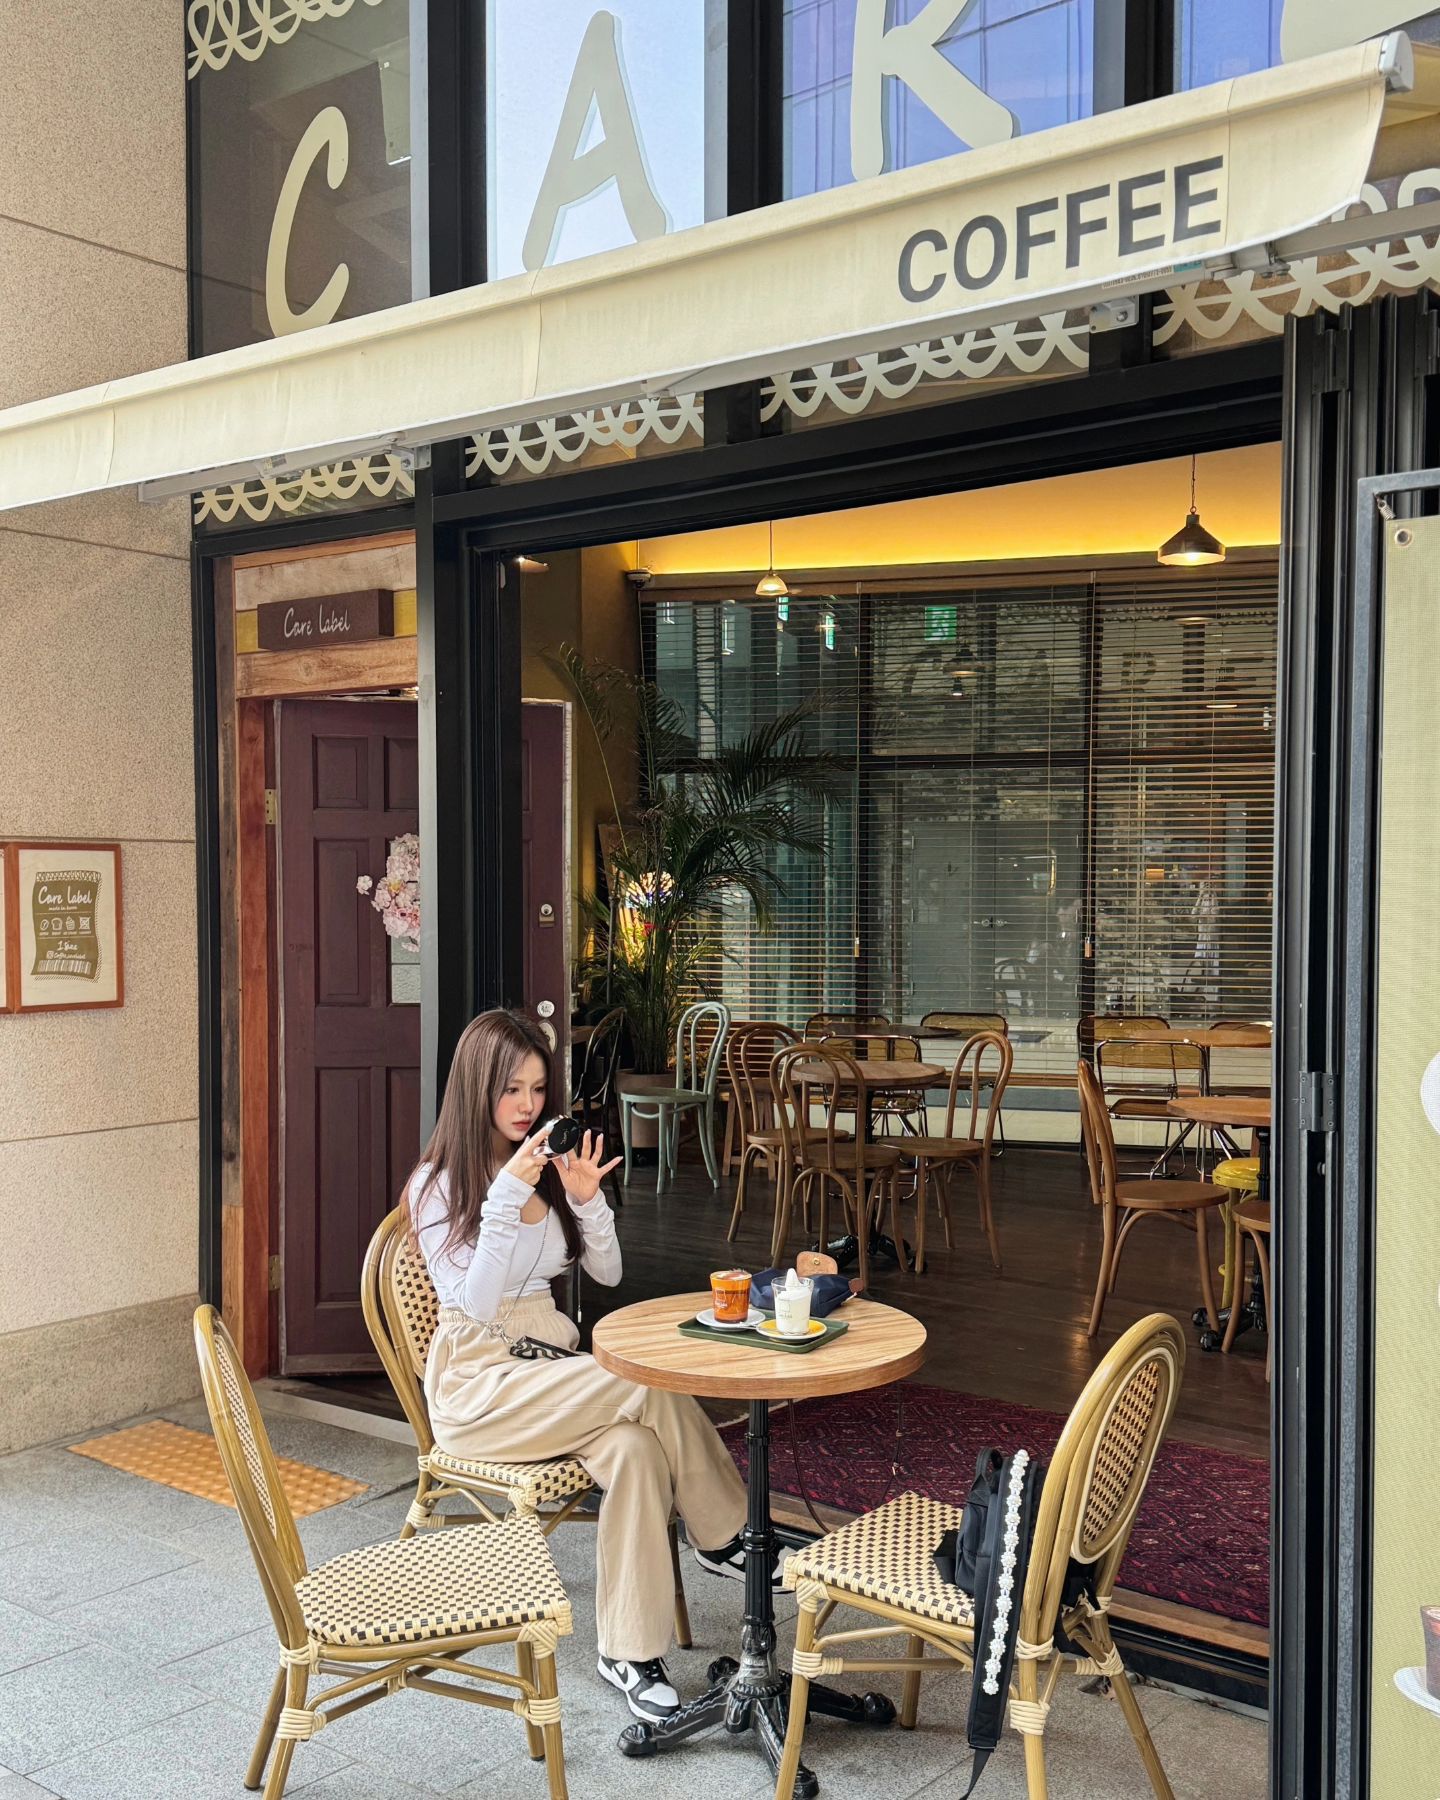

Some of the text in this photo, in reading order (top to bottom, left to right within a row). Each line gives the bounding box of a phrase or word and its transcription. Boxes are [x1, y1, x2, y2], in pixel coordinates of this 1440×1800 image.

[897, 154, 1225, 303] COFFEE
[283, 606, 313, 638] Care
[38, 885, 63, 905] Care
